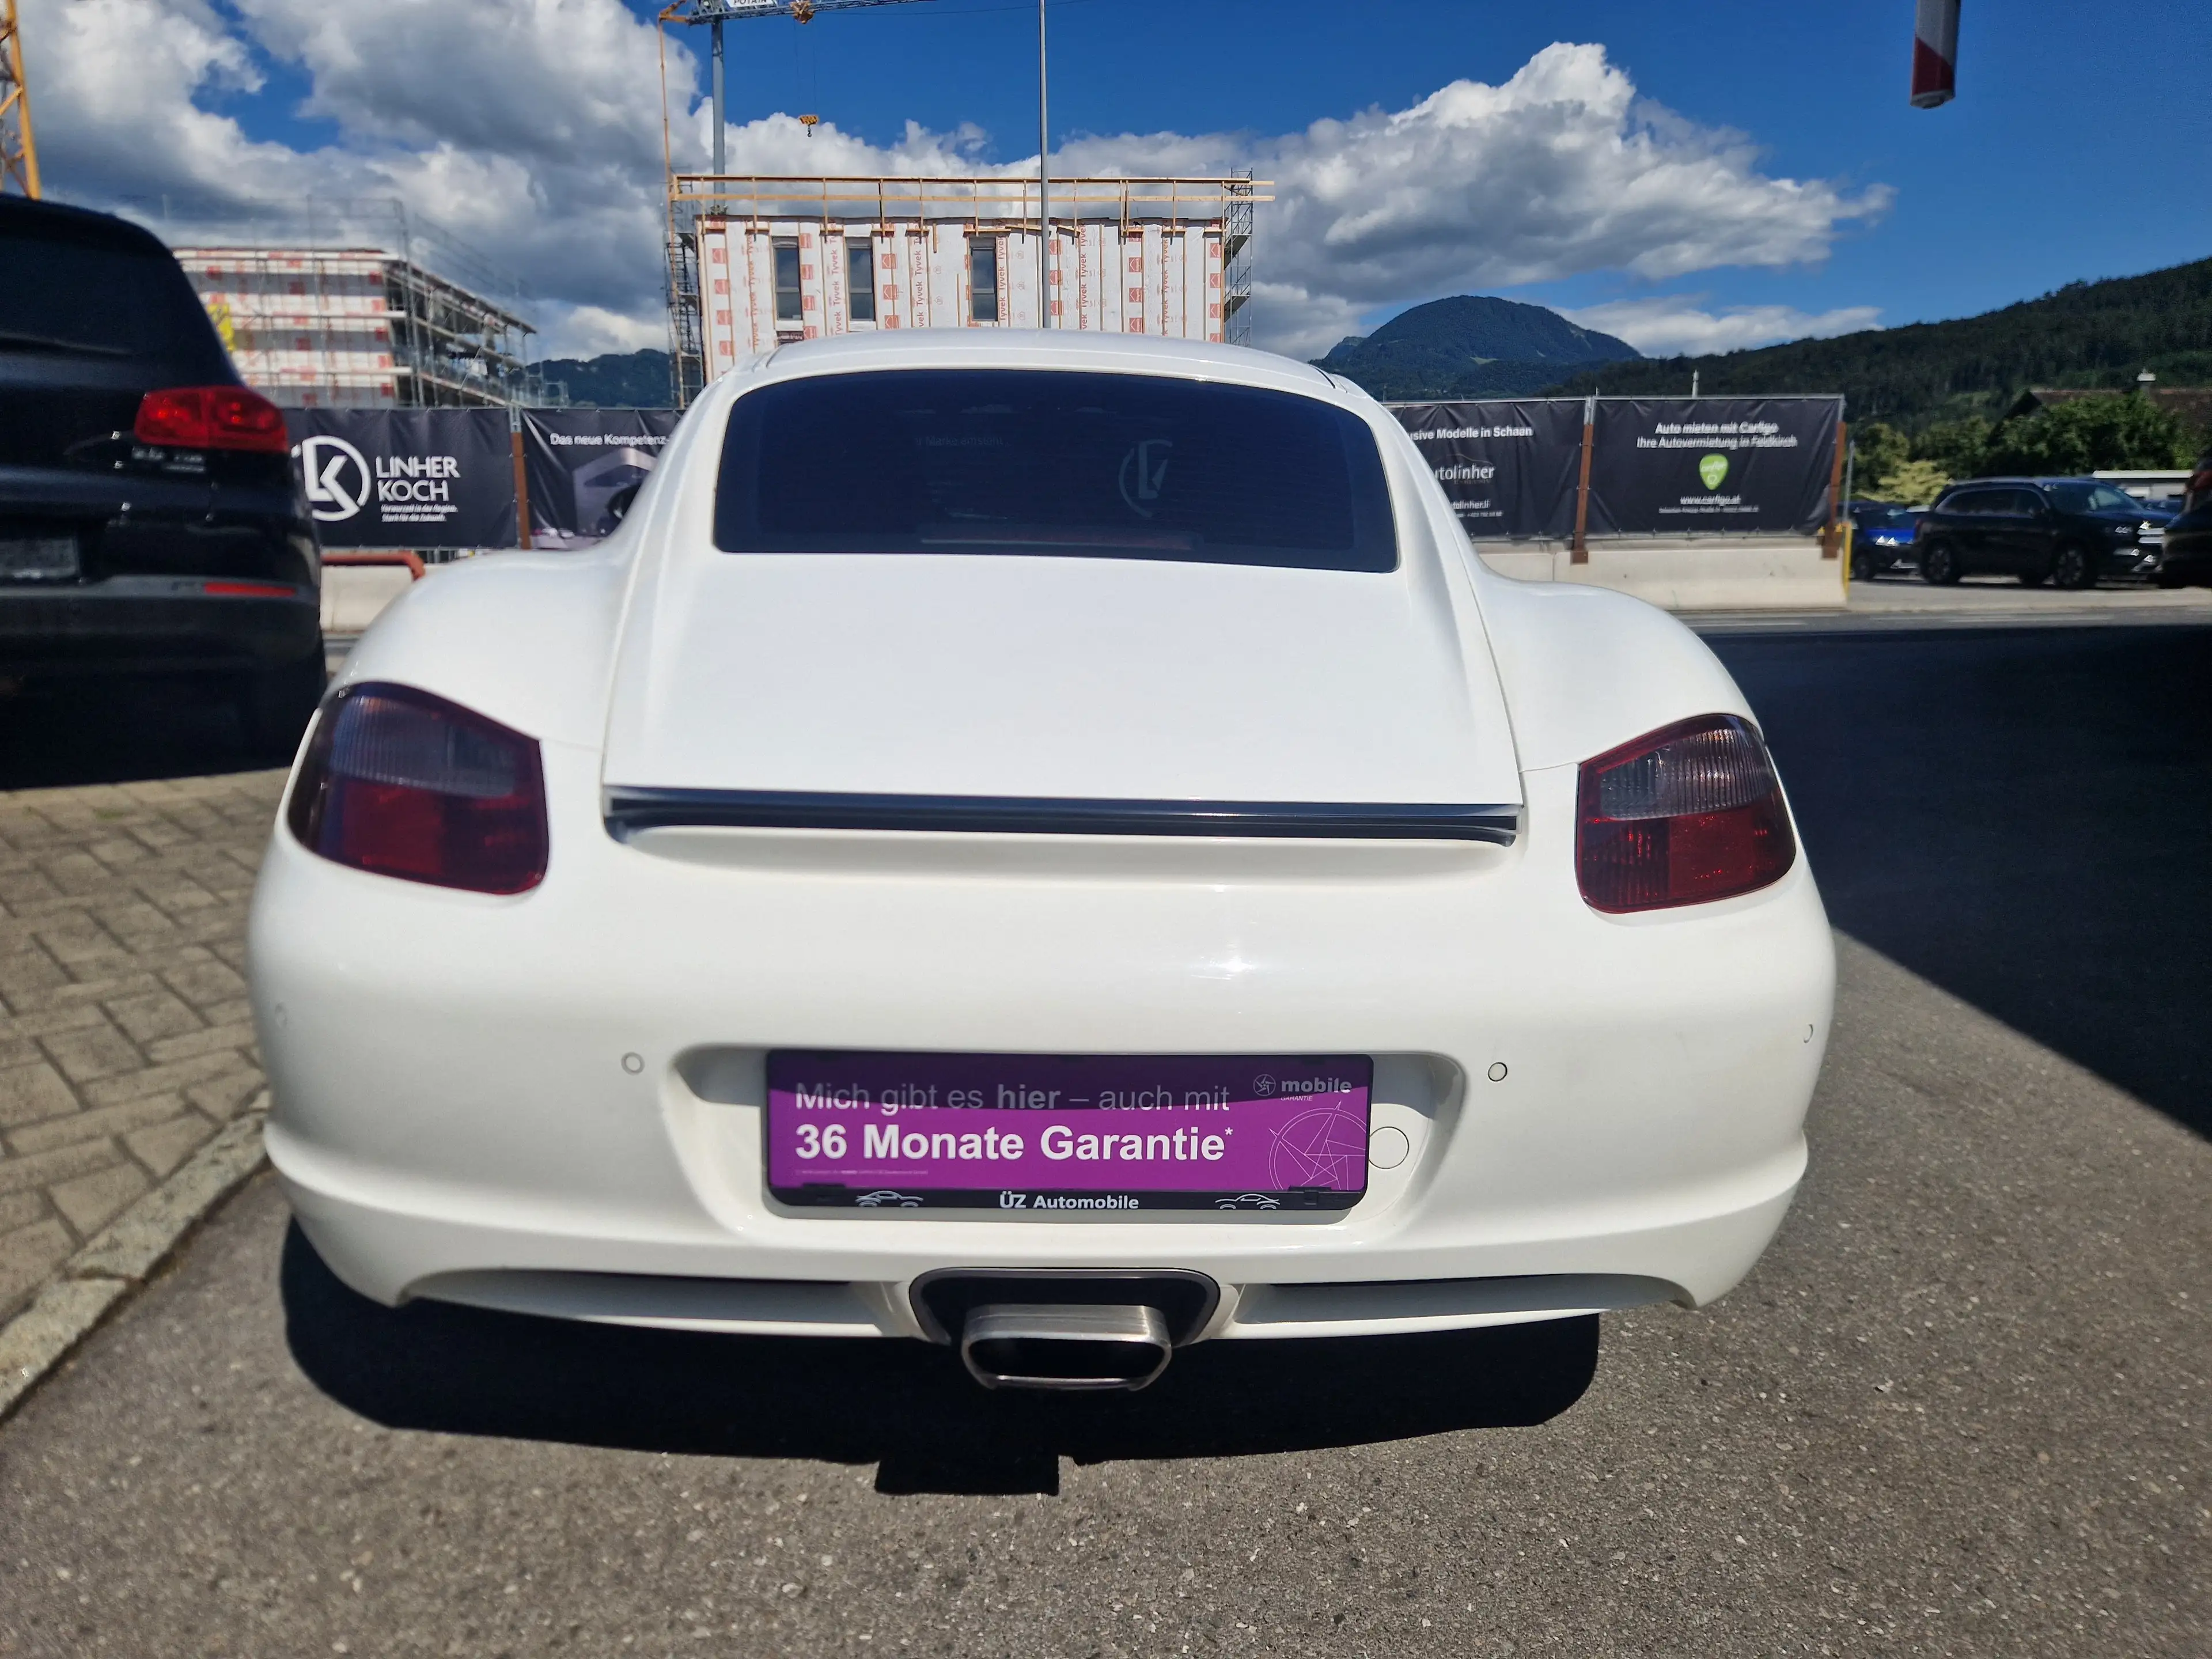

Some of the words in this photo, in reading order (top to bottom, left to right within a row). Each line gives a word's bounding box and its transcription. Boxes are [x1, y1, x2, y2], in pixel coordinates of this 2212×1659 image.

[830, 249, 839, 275] Tyvek
[914, 249, 923, 276] Tyvek
[832, 281, 841, 306] Tyvek
[915, 281, 925, 306] Tyvek
[550, 433, 573, 445] Das
[574, 435, 603, 445] neue
[1437, 426, 1479, 438] Modelle
[1480, 427, 1491, 438] in
[1493, 425, 1533, 437] Schaan
[1637, 436, 1657, 448] Ihre
[376, 456, 461, 478] LINHER
[377, 479, 449, 502] KOCH
[1281, 1077, 1352, 1093] mobile
[796, 1083, 870, 1109] Mich
[881, 1084, 938, 1116] gibt
[948, 1089, 983, 1109] es
[998, 1084, 1061, 1109] hier
[1099, 1085, 1172, 1111] auch
[1184, 1086, 1230, 1111] mit
[796, 1124, 847, 1160] 36
[863, 1124, 1024, 1160] Monate
[999, 1191, 1027, 1209] ÜZ
[1033, 1195, 1139, 1209] Automobile
